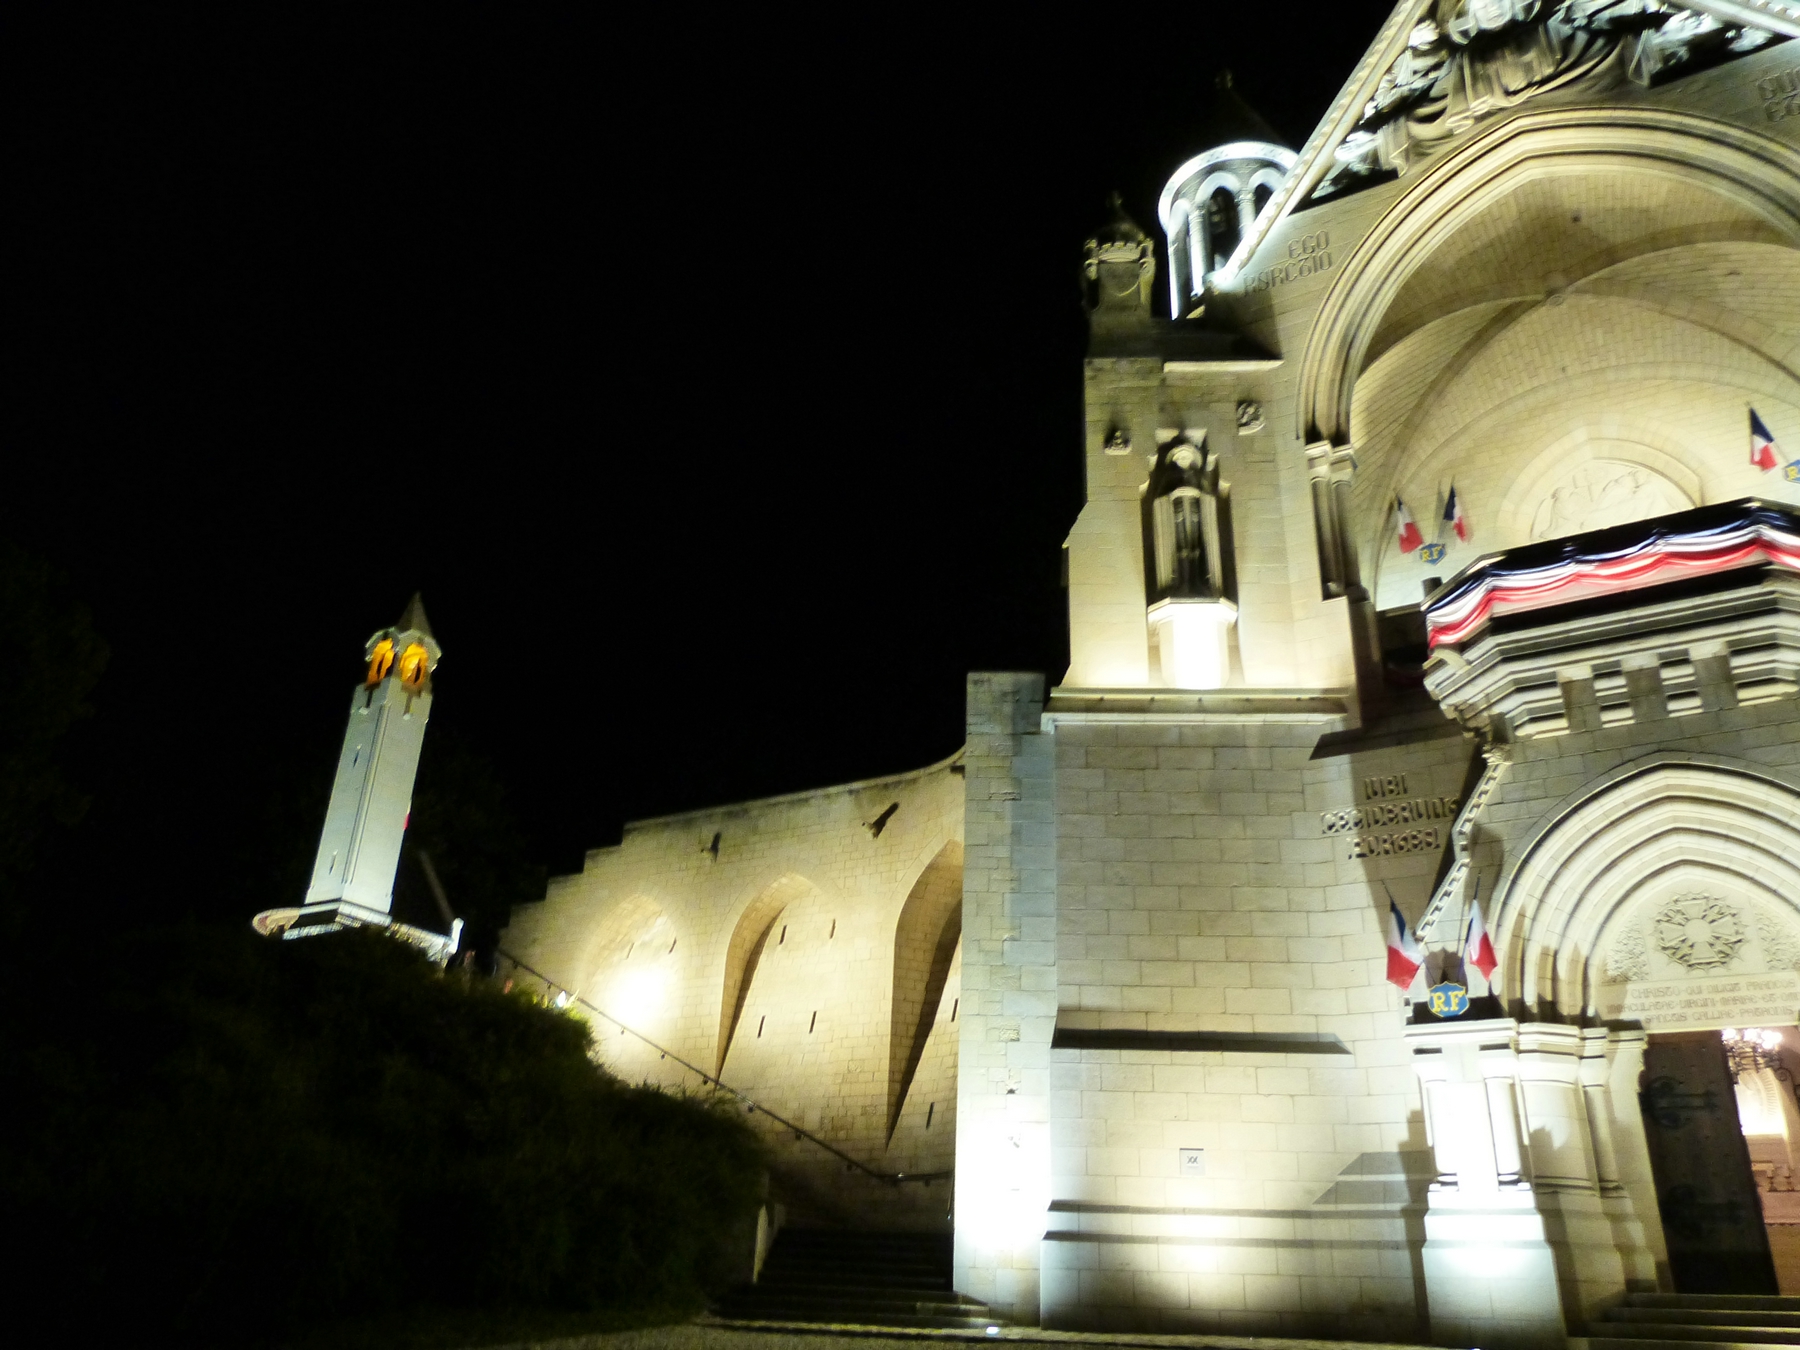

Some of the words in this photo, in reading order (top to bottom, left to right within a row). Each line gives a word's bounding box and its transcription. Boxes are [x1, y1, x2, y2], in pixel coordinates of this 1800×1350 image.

[1287, 229, 1330, 260] EGO
[1421, 546, 1442, 562] RF
[1364, 773, 1408, 800] UBI
[1430, 990, 1466, 1013] RF
